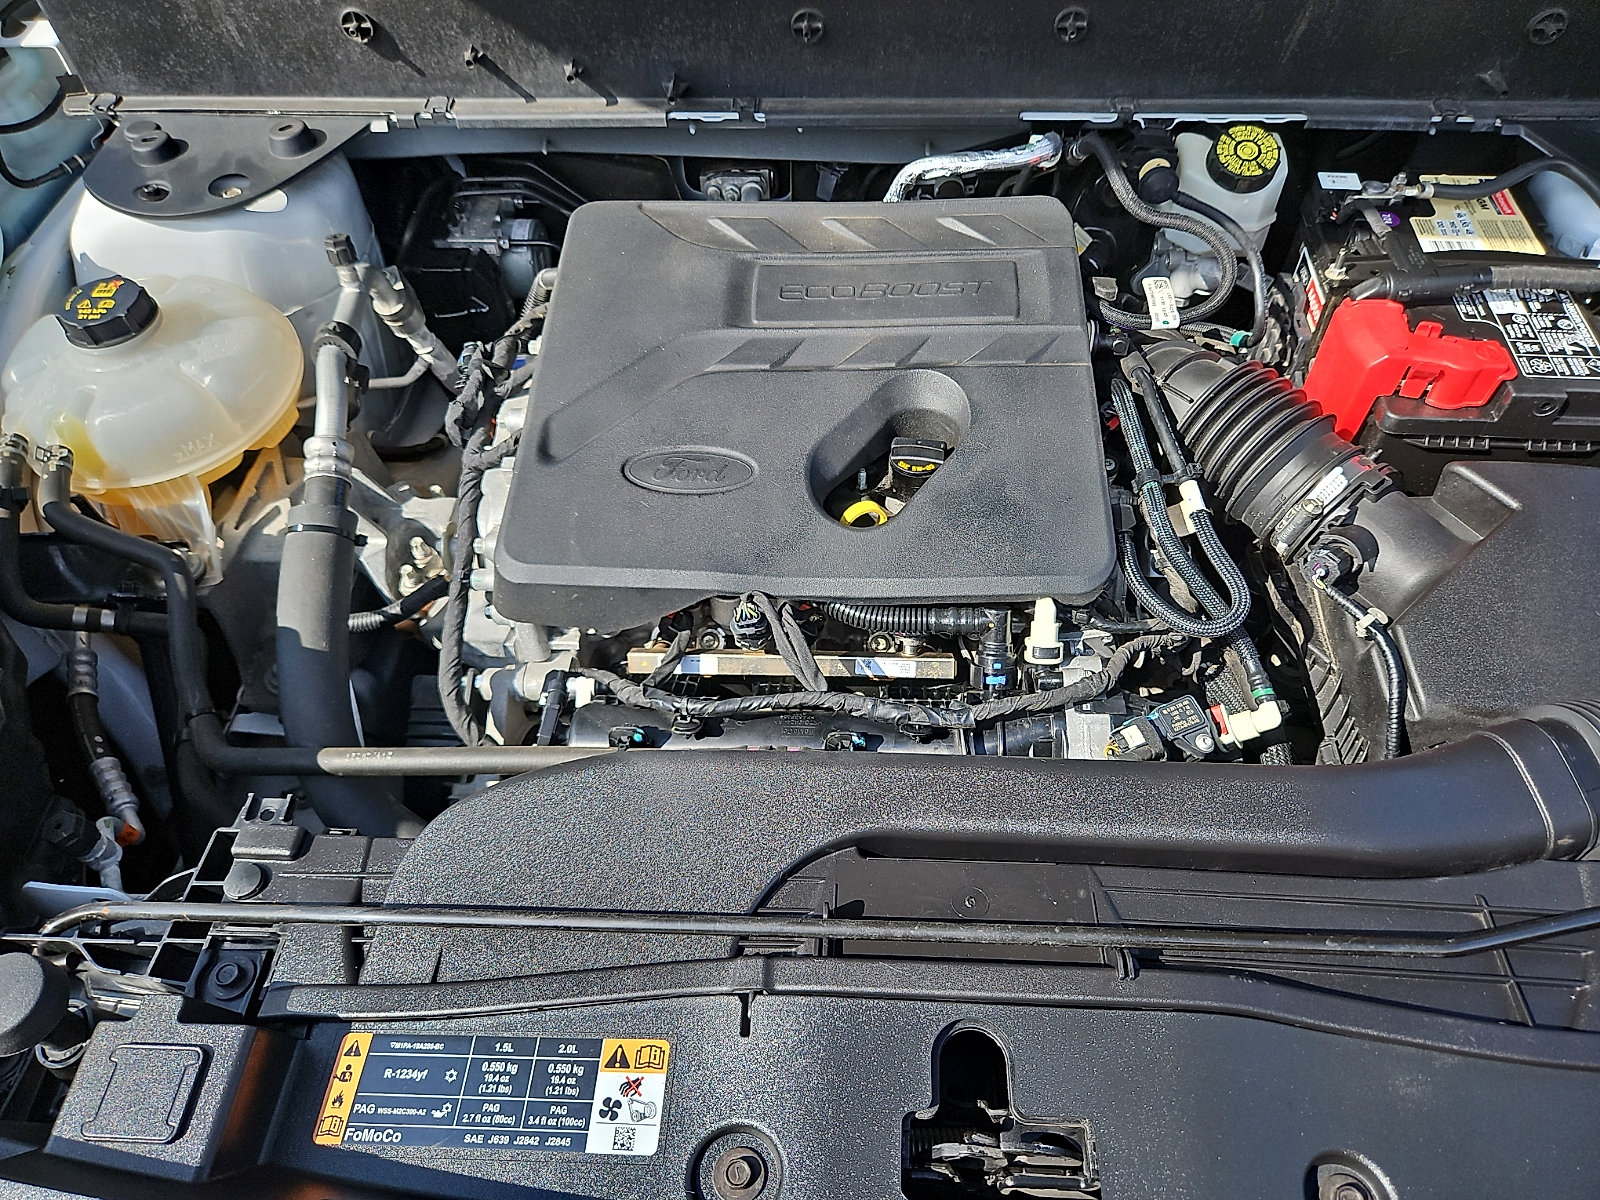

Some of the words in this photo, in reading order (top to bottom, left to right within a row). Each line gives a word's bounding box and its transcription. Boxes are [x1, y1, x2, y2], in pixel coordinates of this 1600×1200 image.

[778, 280, 992, 301] ECOBOOST
[652, 456, 729, 483] Ford
[494, 1043, 514, 1052] 1.5L
[557, 1044, 579, 1054] 2.0L
[383, 1068, 429, 1081] R-1234yf
[481, 1062, 505, 1072] 0.550
[506, 1062, 519, 1075] kg
[547, 1063, 571, 1073] 0.550
[572, 1064, 584, 1076] kg
[484, 1074, 499, 1083] 19.4
[500, 1075, 510, 1083] oz
[550, 1076, 566, 1084] 19.4
[566, 1077, 577, 1085] oz
[478, 1084, 496, 1094] (1.21
[497, 1084, 513, 1095] lbs)
[545, 1085, 563, 1096] (1.21
[564, 1086, 579, 1097] lbs)
[352, 1104, 376, 1114] PAG
[482, 1103, 501, 1113] PAG
[549, 1105, 568, 1115] PAG
[462, 1113, 475, 1123] 2.7
[475, 1114, 482, 1123] fl
[482, 1116, 492, 1124] oz
[492, 1114, 516, 1125] (80cc)
[528, 1115, 540, 1125] 3.4
[540, 1116, 547, 1125] fl
[547, 1117, 557, 1126] oz
[557, 1117, 586, 1128] (100cc)
[344, 1128, 402, 1142] FoMoCo
[463, 1134, 484, 1144] SAE
[488, 1134, 509, 1144] J639
[513, 1135, 540, 1145] J2842
[544, 1136, 572, 1146] J2845
